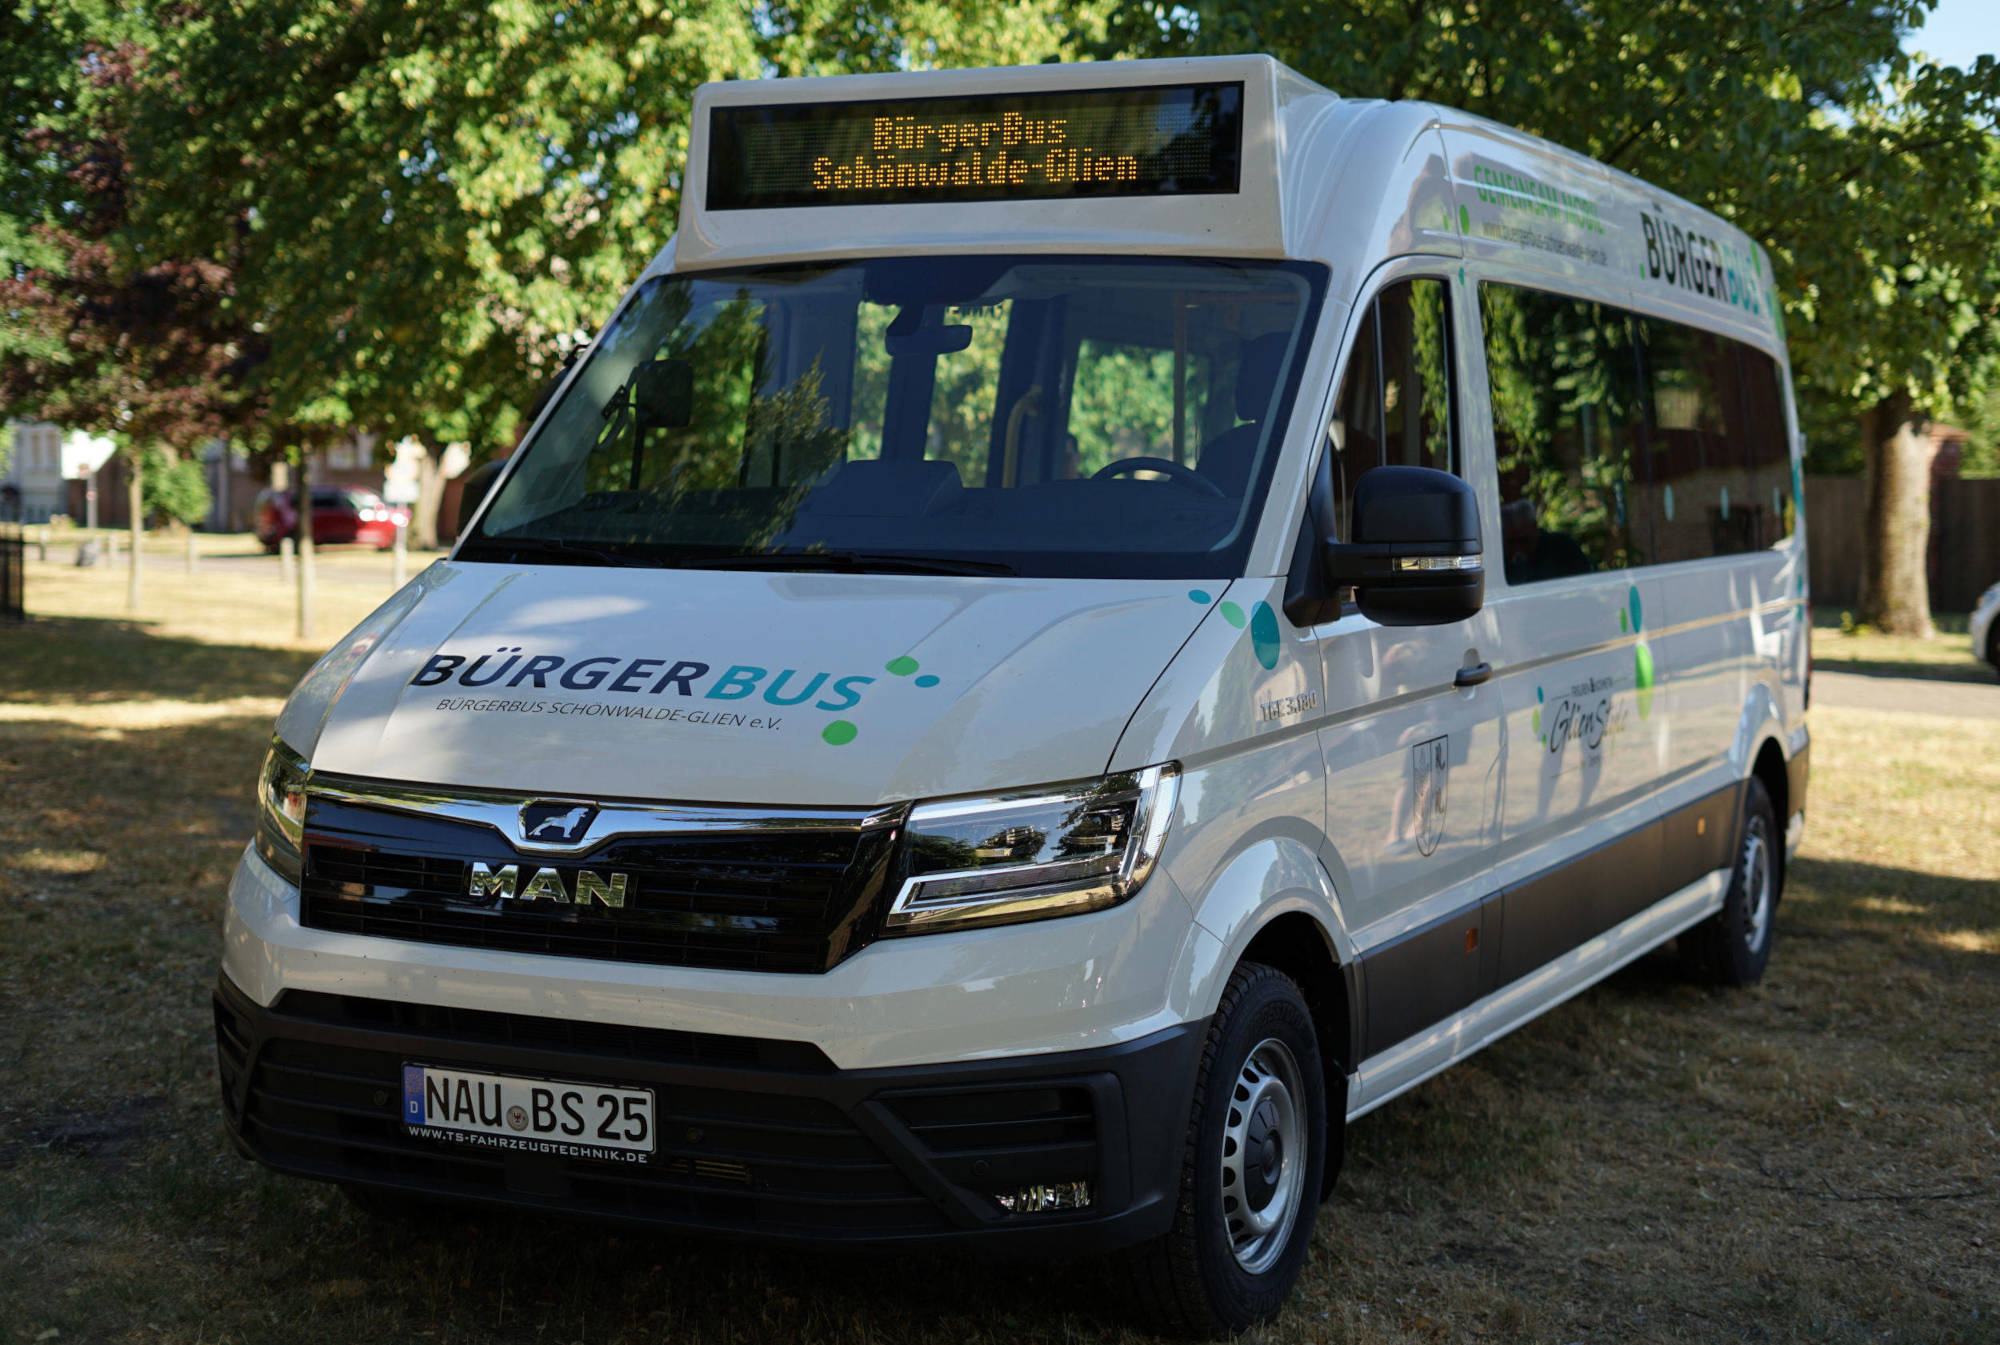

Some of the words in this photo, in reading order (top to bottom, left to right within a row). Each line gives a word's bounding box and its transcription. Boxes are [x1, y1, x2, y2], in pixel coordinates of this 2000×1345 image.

[873, 111, 1067, 153] BürgerBus
[812, 147, 1138, 191] Schönwalde-Glien
[409, 646, 876, 712] BÜRGERBUS
[436, 697, 543, 713] BÜRGERBUS
[548, 700, 747, 728] SCHÖNWALDE-GLIEN
[750, 716, 781, 731] e.V.
[469, 861, 629, 908] MAN
[410, 1100, 419, 1114] D
[426, 1075, 503, 1127] NAU
[531, 1087, 585, 1136] BS
[597, 1094, 648, 1142] 25
[408, 1126, 648, 1164] WWW.TS-FAHRZEUGTECHNIK.DE
